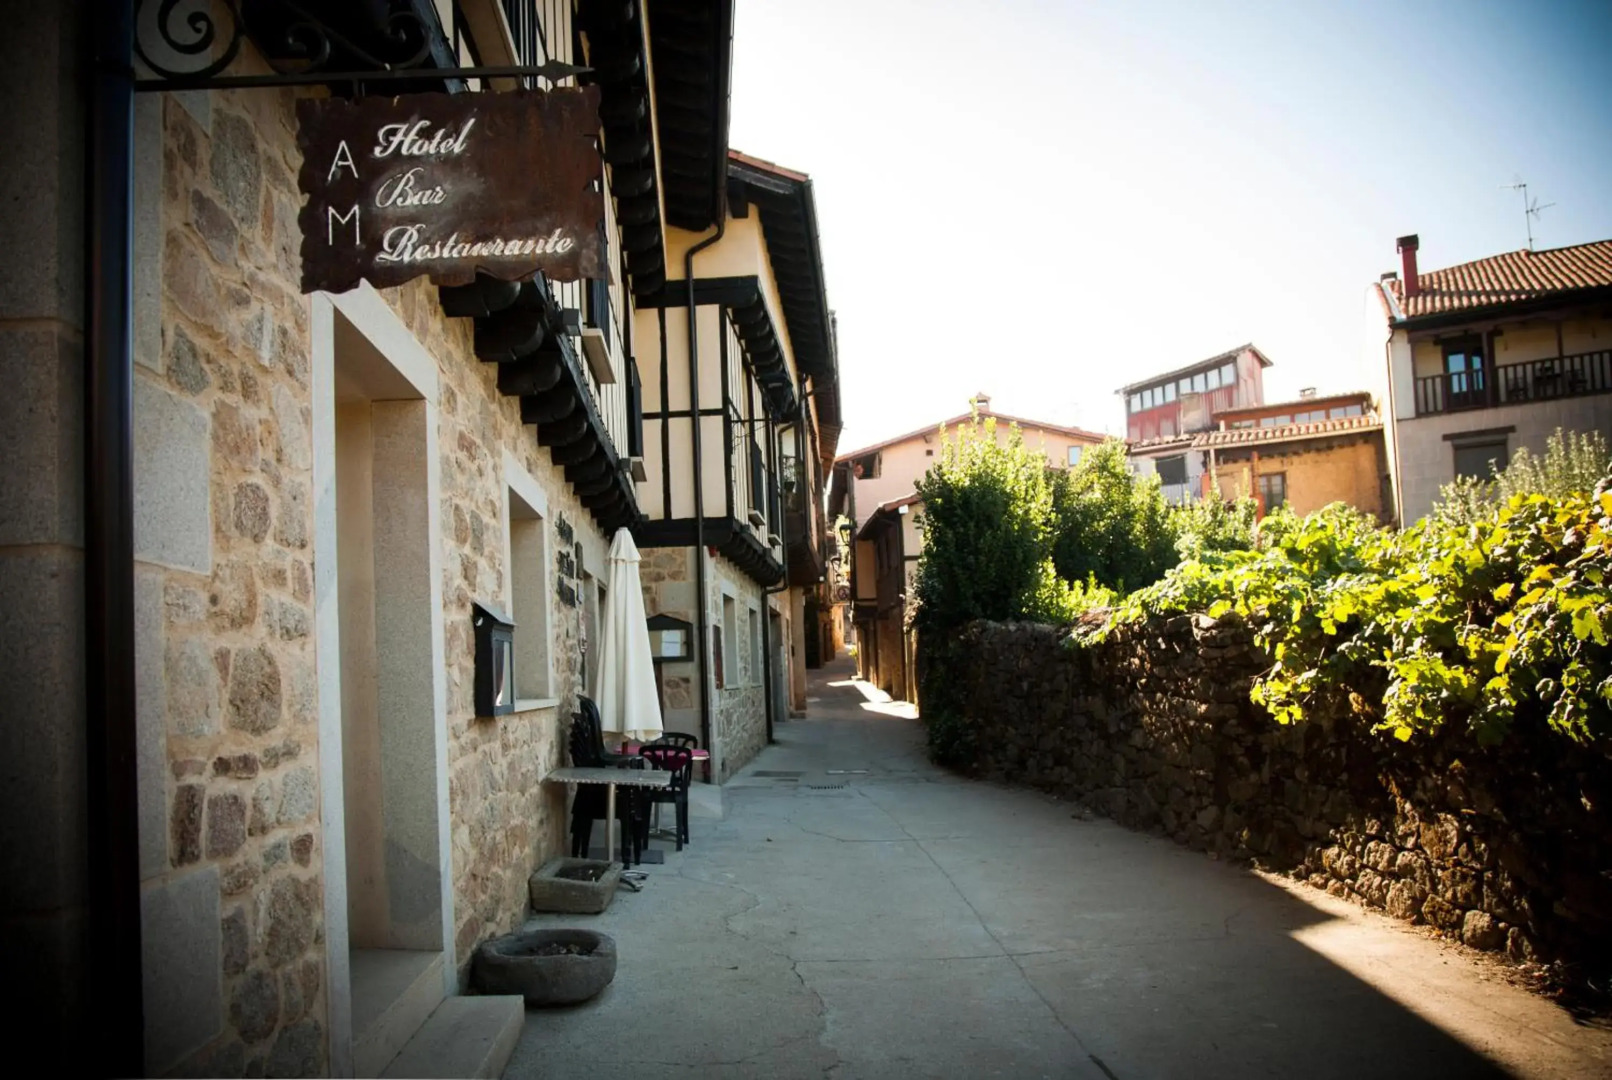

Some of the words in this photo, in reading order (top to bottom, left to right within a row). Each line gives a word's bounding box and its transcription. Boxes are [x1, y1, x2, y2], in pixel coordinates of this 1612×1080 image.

[373, 117, 477, 158] Hotel
[375, 167, 447, 208] Bar
[375, 223, 575, 264] Restaurante
